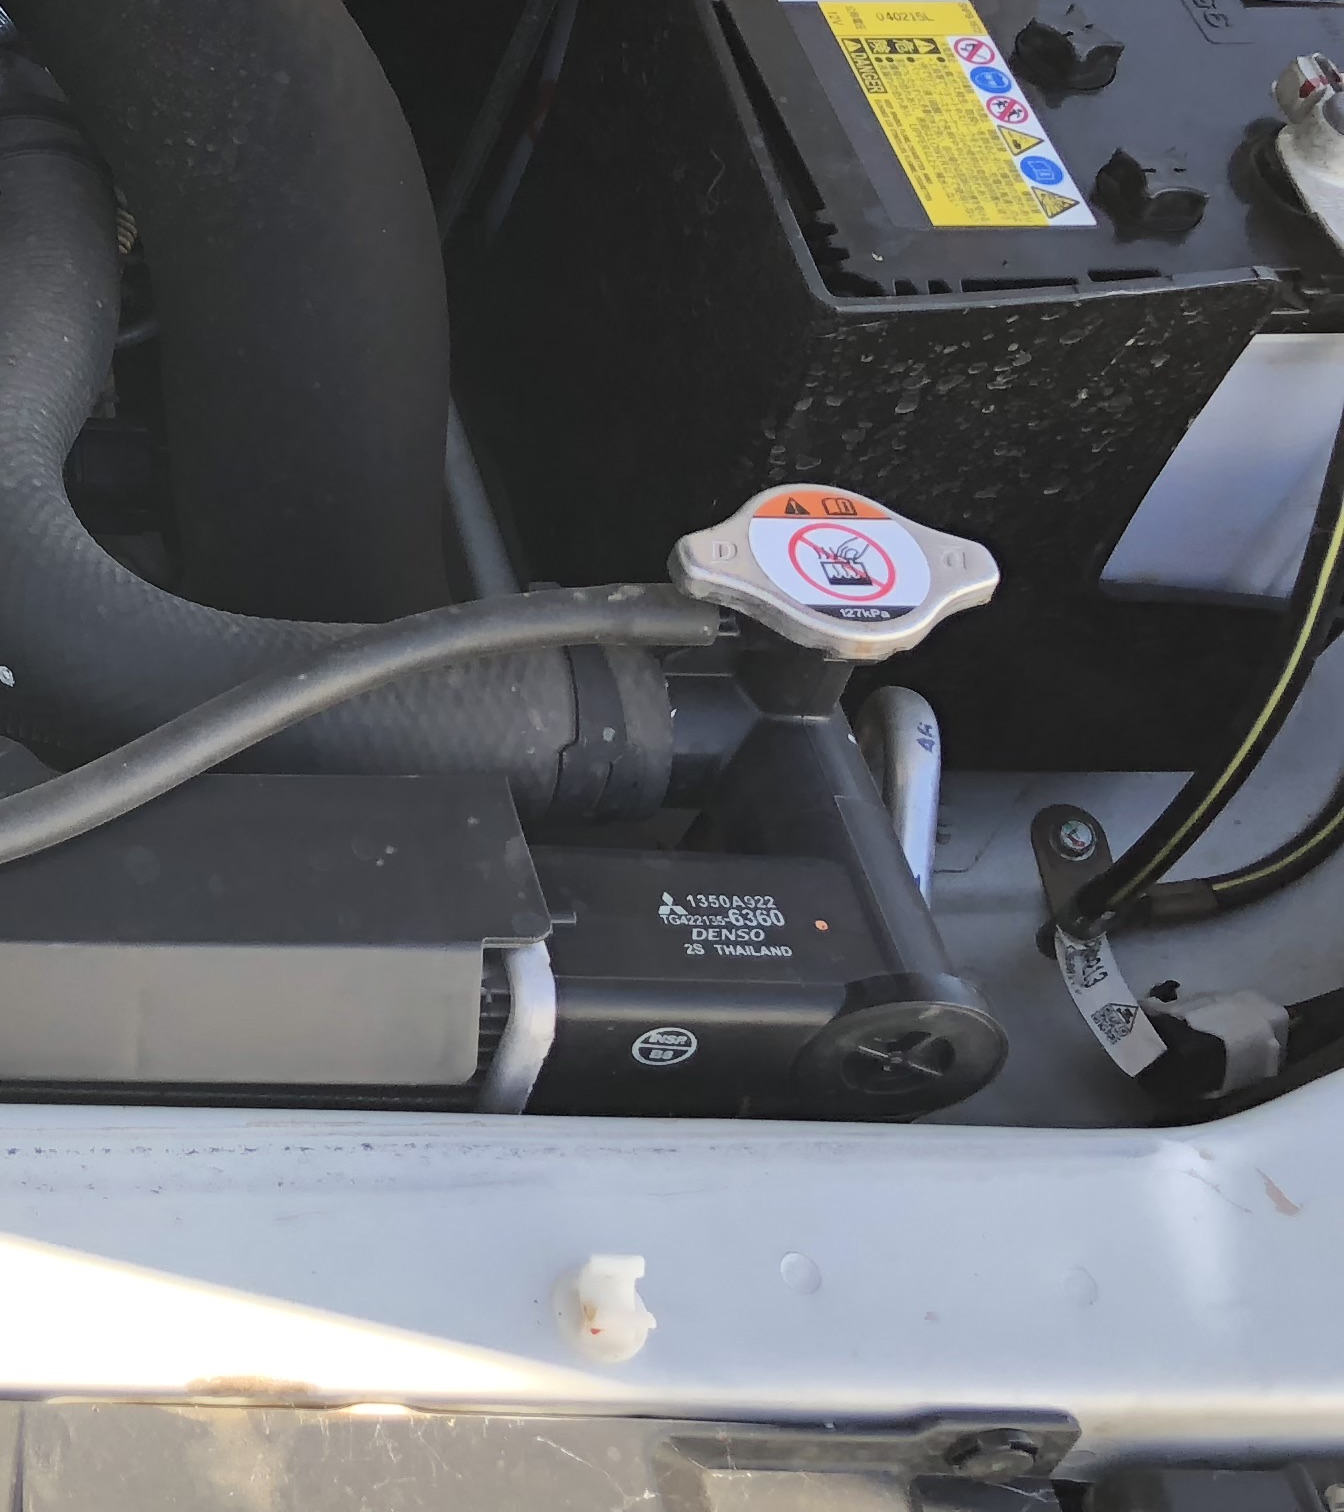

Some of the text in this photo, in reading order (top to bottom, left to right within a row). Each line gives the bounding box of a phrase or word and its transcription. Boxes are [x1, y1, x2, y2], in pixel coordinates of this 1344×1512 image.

[851, 51, 887, 94] DANGER
[839, 607, 891, 619] 127kPa
[686, 894, 777, 909] 1350A922
[691, 928, 765, 942] DENSO
[684, 942, 793, 957] 2S THAILAND
